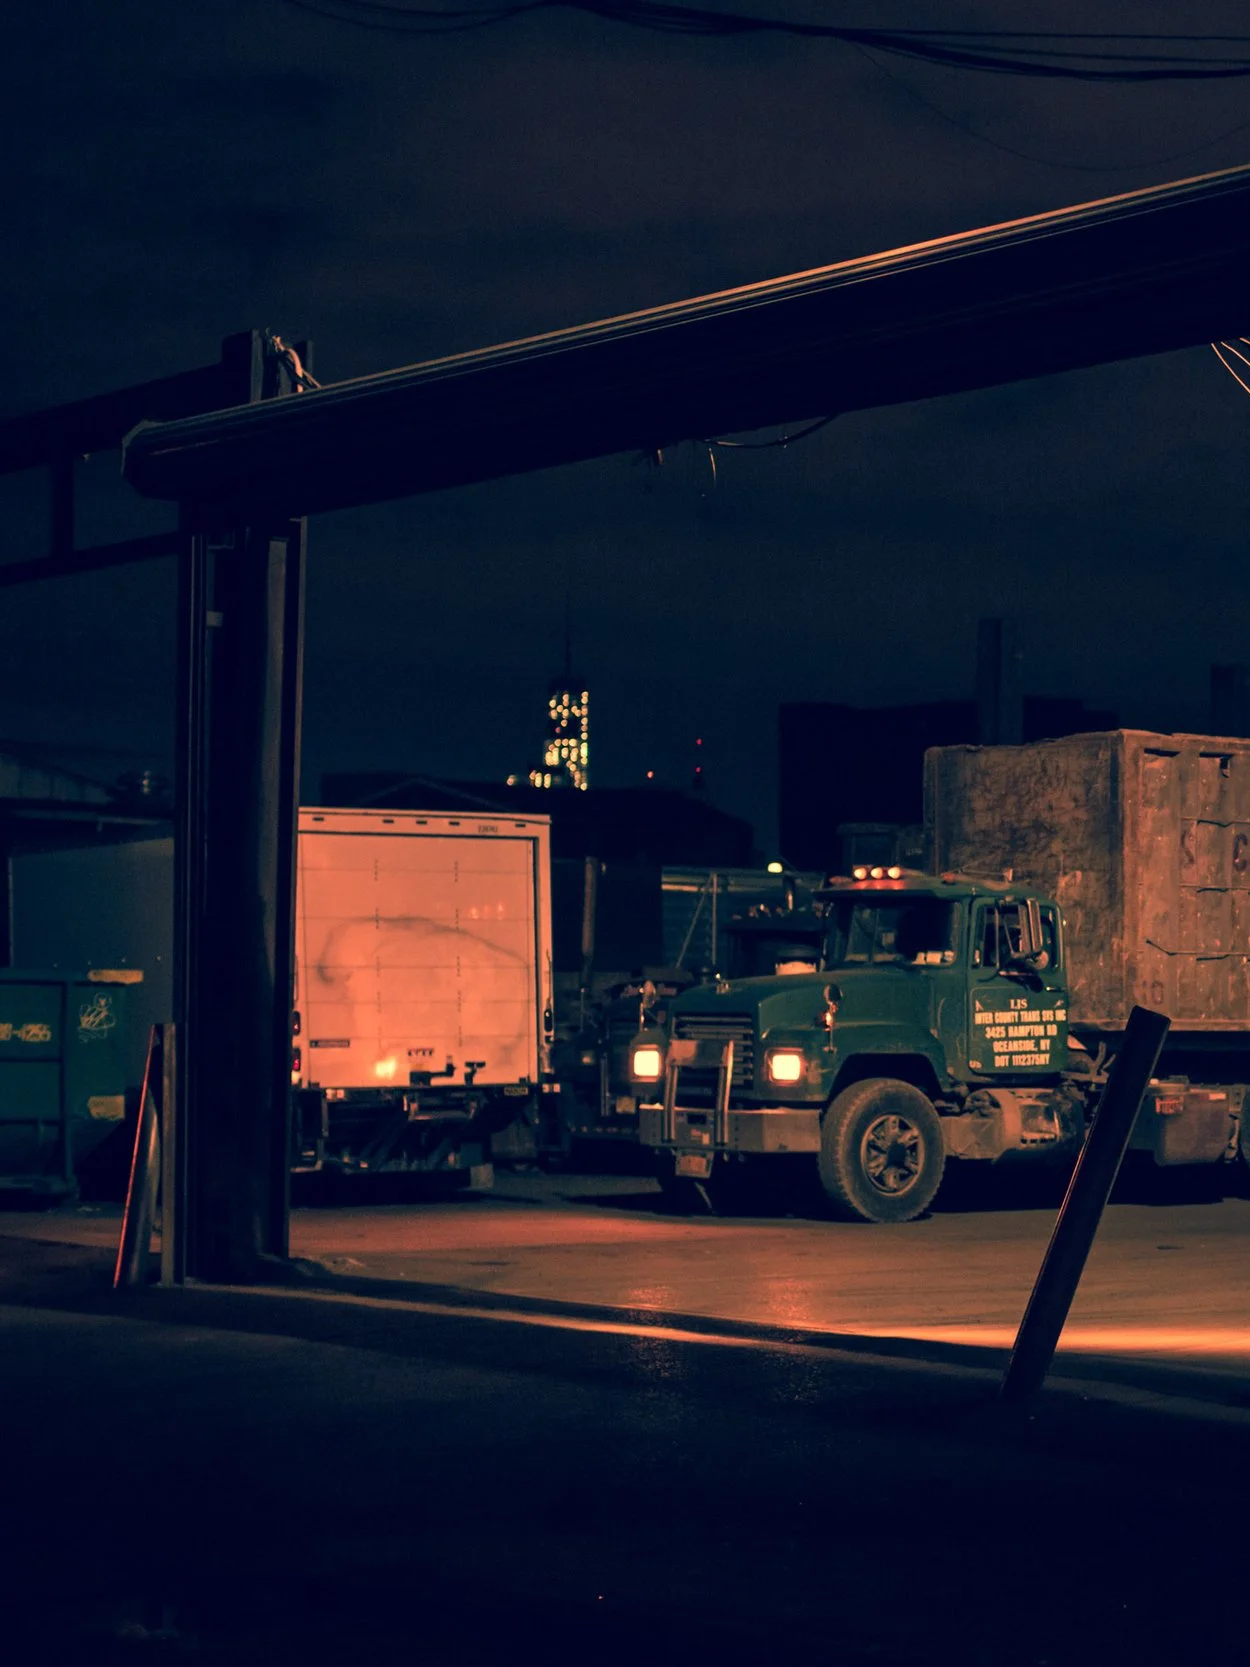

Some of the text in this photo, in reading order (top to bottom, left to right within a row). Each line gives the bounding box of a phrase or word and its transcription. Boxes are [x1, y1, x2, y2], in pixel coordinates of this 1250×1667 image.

[994, 1011, 1019, 1024] COUNTY
[985, 1023, 1058, 1039] 3425 HAMPTON RD
[992, 1039, 1051, 1053] OCEANSIDE, NY
[994, 1055, 1010, 1067] DOT
